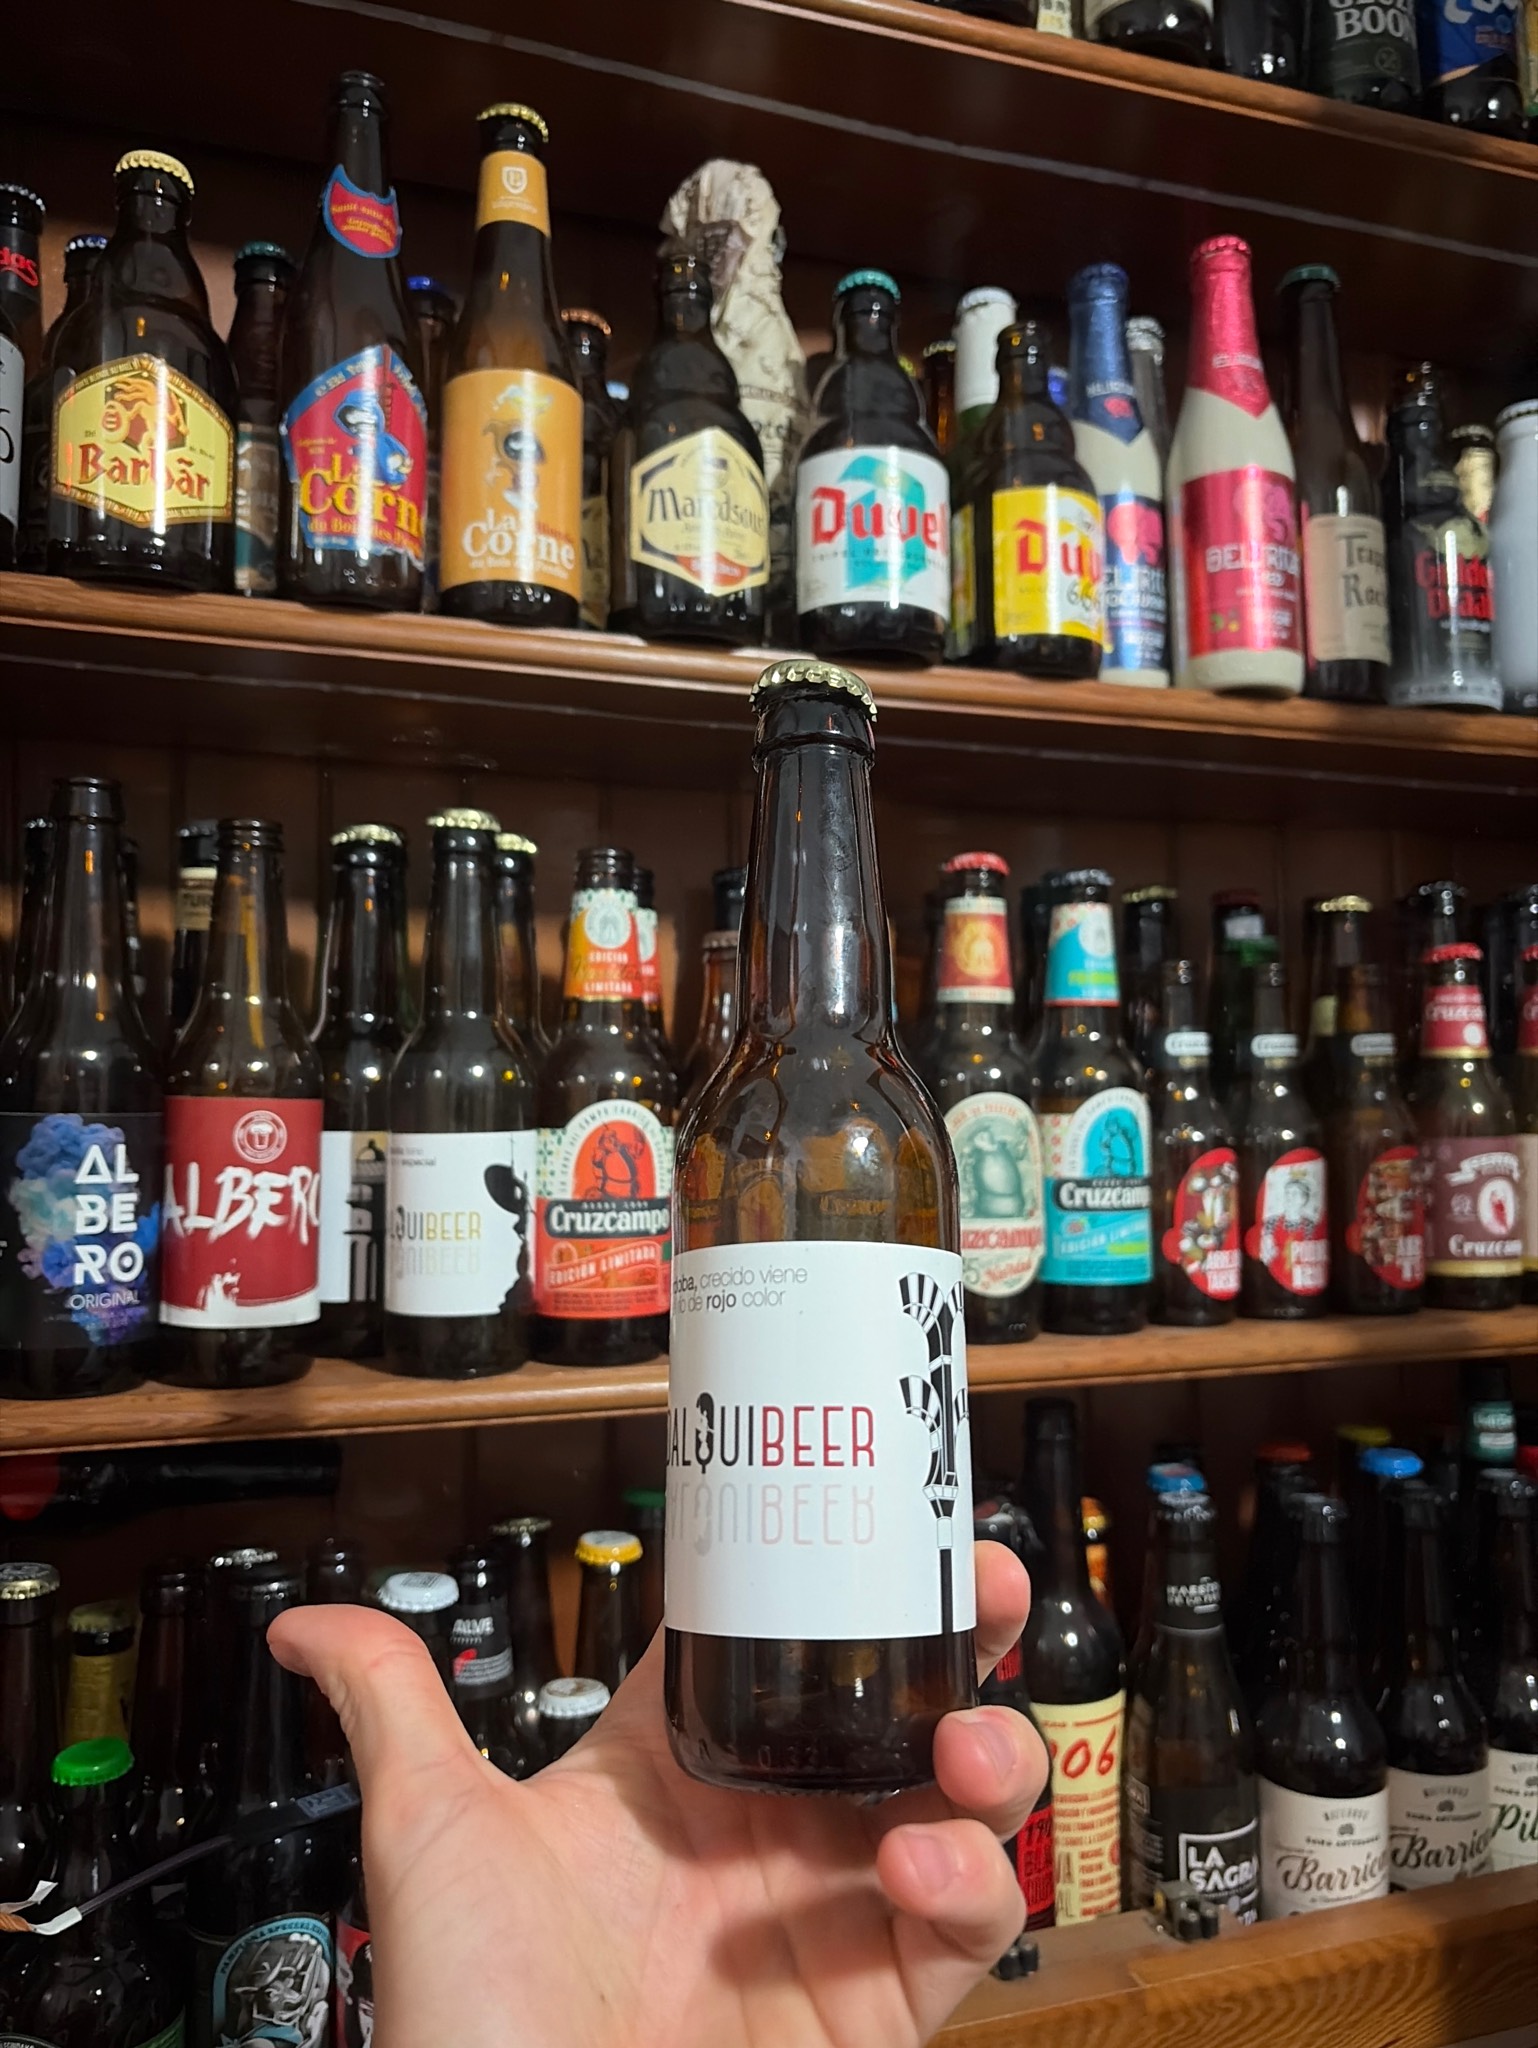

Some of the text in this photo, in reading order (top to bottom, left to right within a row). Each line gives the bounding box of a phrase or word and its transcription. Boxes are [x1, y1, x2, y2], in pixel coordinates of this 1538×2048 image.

[812, 486, 949, 556] Duvel
[74, 1143, 139, 1184] AL
[75, 1192, 138, 1235] BE
[550, 1204, 669, 1235] Cruzcampo
[74, 1241, 144, 1285] RO
[700, 1266, 755, 1289] crecido
[759, 1264, 808, 1285] viene
[70, 1290, 140, 1311] ORIGINAL
[706, 1289, 737, 1313] rojo
[742, 1287, 786, 1308] color
[1049, 1725, 1116, 1779] 06
[1187, 1846, 1226, 1869] LA
